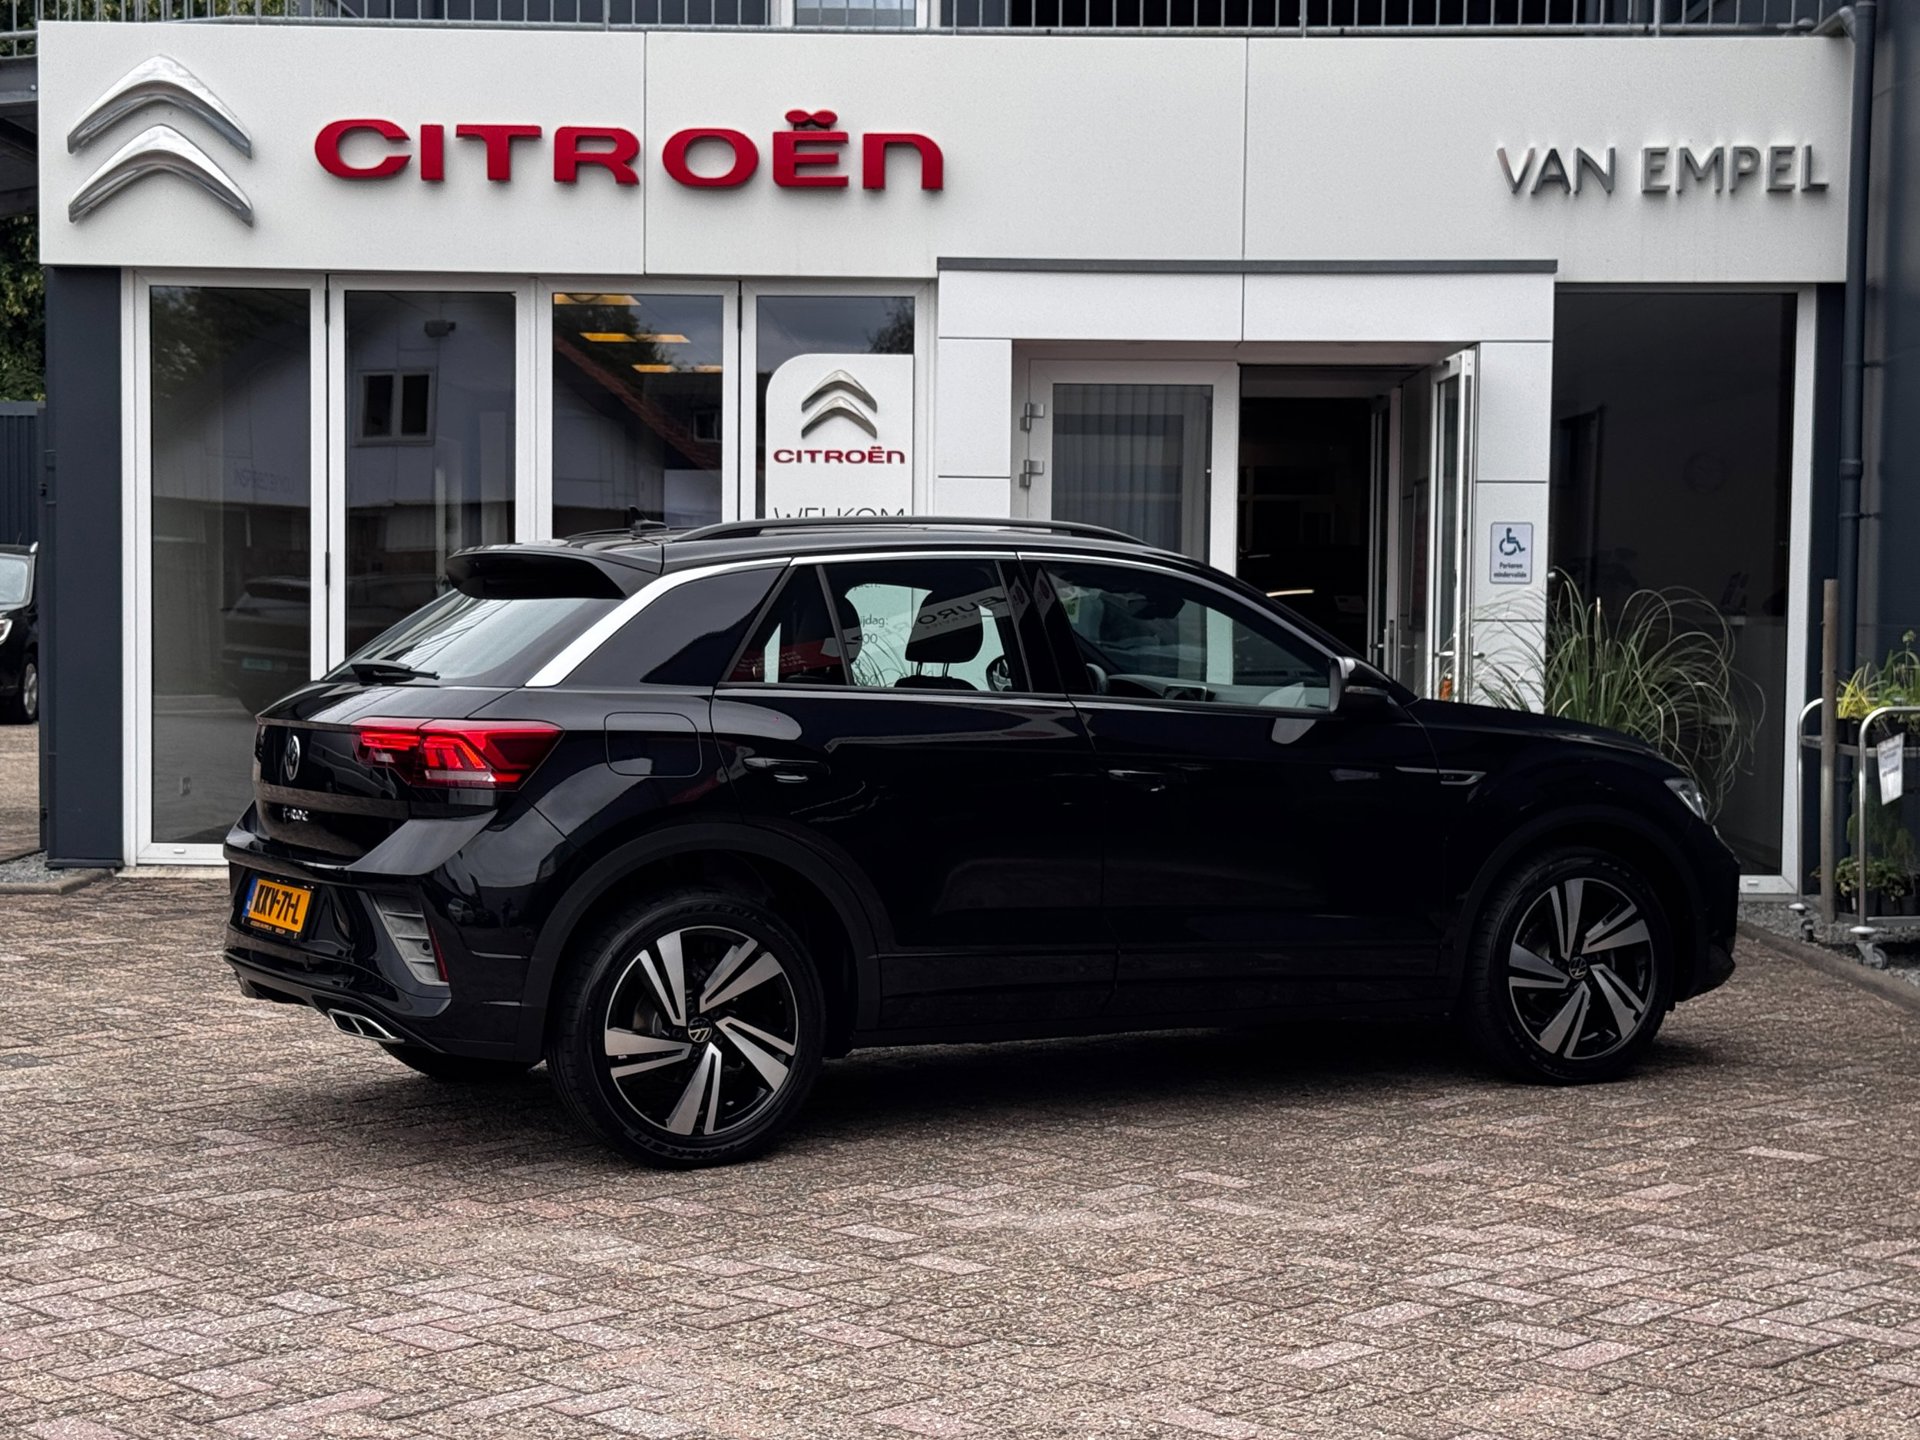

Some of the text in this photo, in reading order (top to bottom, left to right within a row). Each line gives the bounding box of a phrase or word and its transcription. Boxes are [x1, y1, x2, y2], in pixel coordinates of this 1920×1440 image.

[314, 109, 944, 191] CITROËN
[1496, 145, 1829, 194] VAN EMPEL
[773, 446, 906, 464] CITROËN
